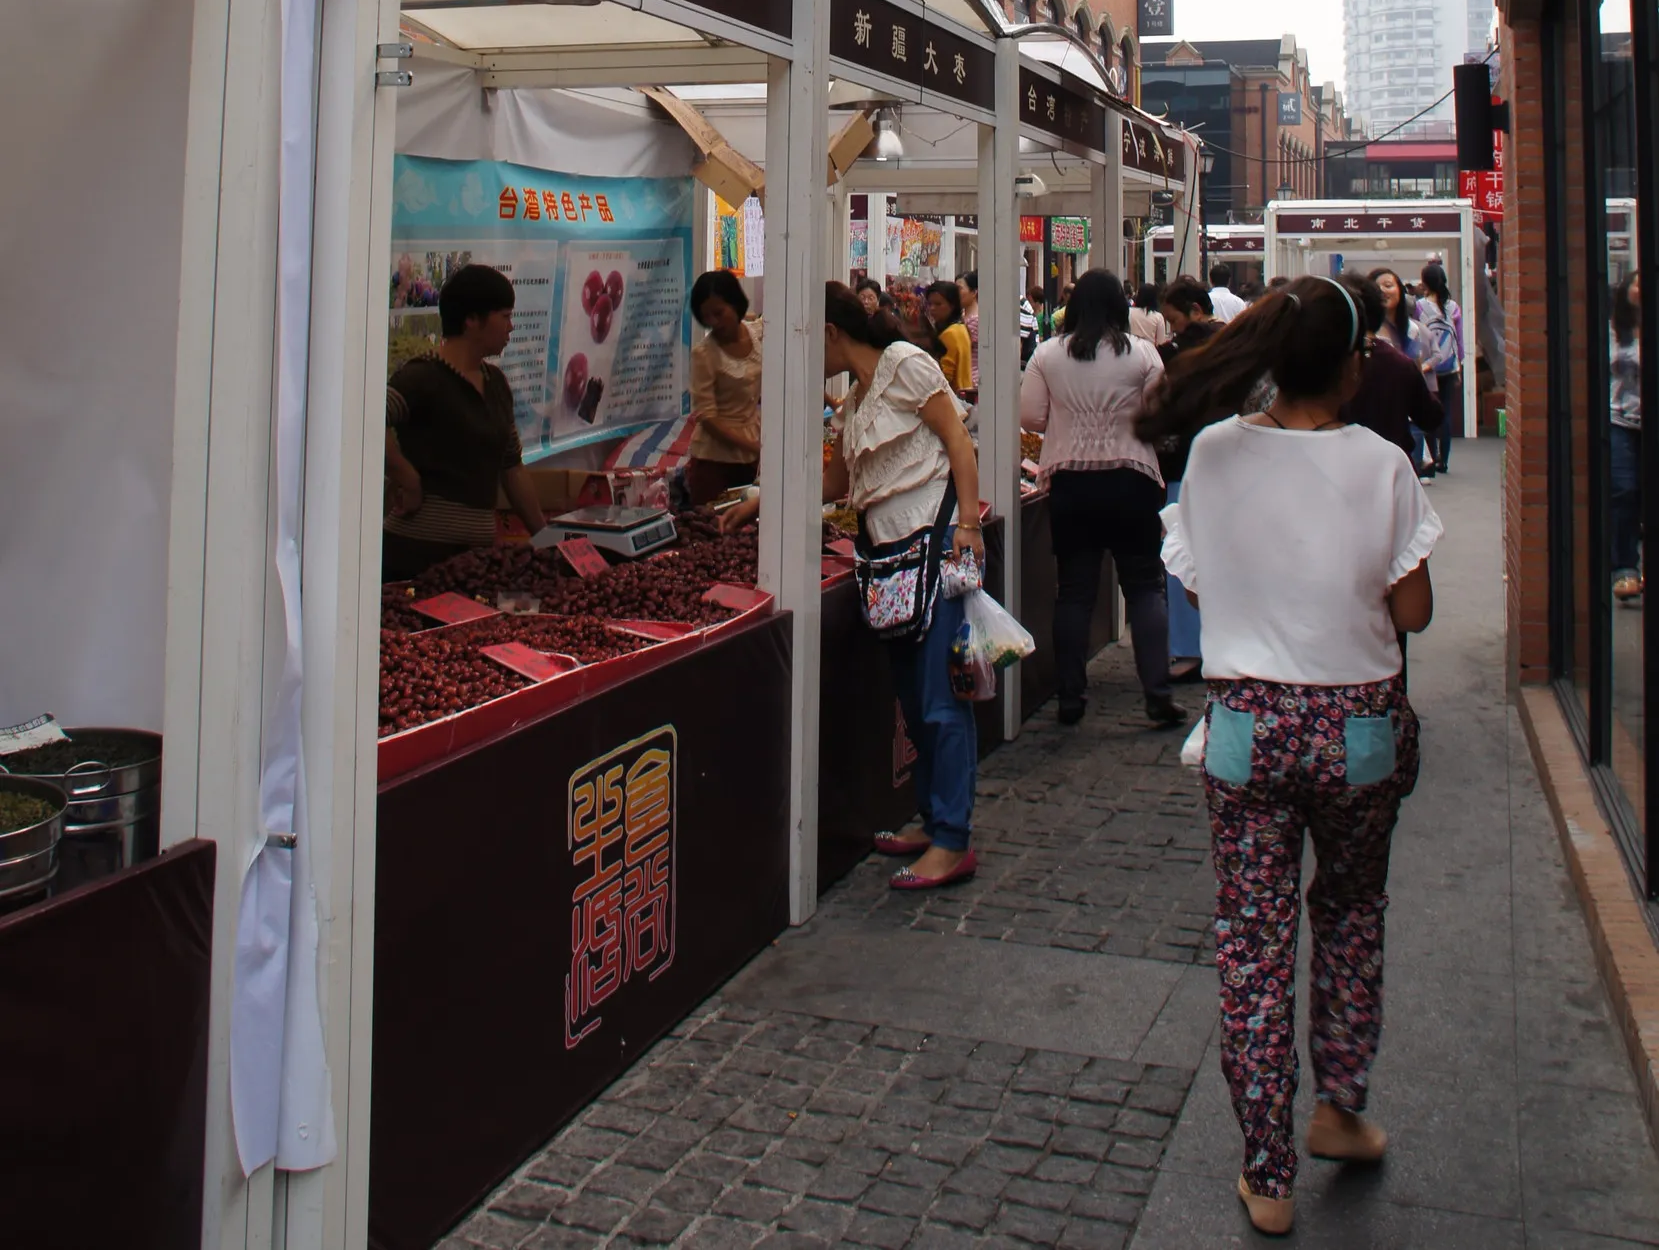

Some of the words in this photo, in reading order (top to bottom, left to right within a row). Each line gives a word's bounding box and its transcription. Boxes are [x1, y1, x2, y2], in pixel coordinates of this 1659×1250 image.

[853, 9, 966, 85] 新疆大枣
[498, 185, 615, 223] 台湾特色产品
[1310, 217, 1426, 230] 南北干货
